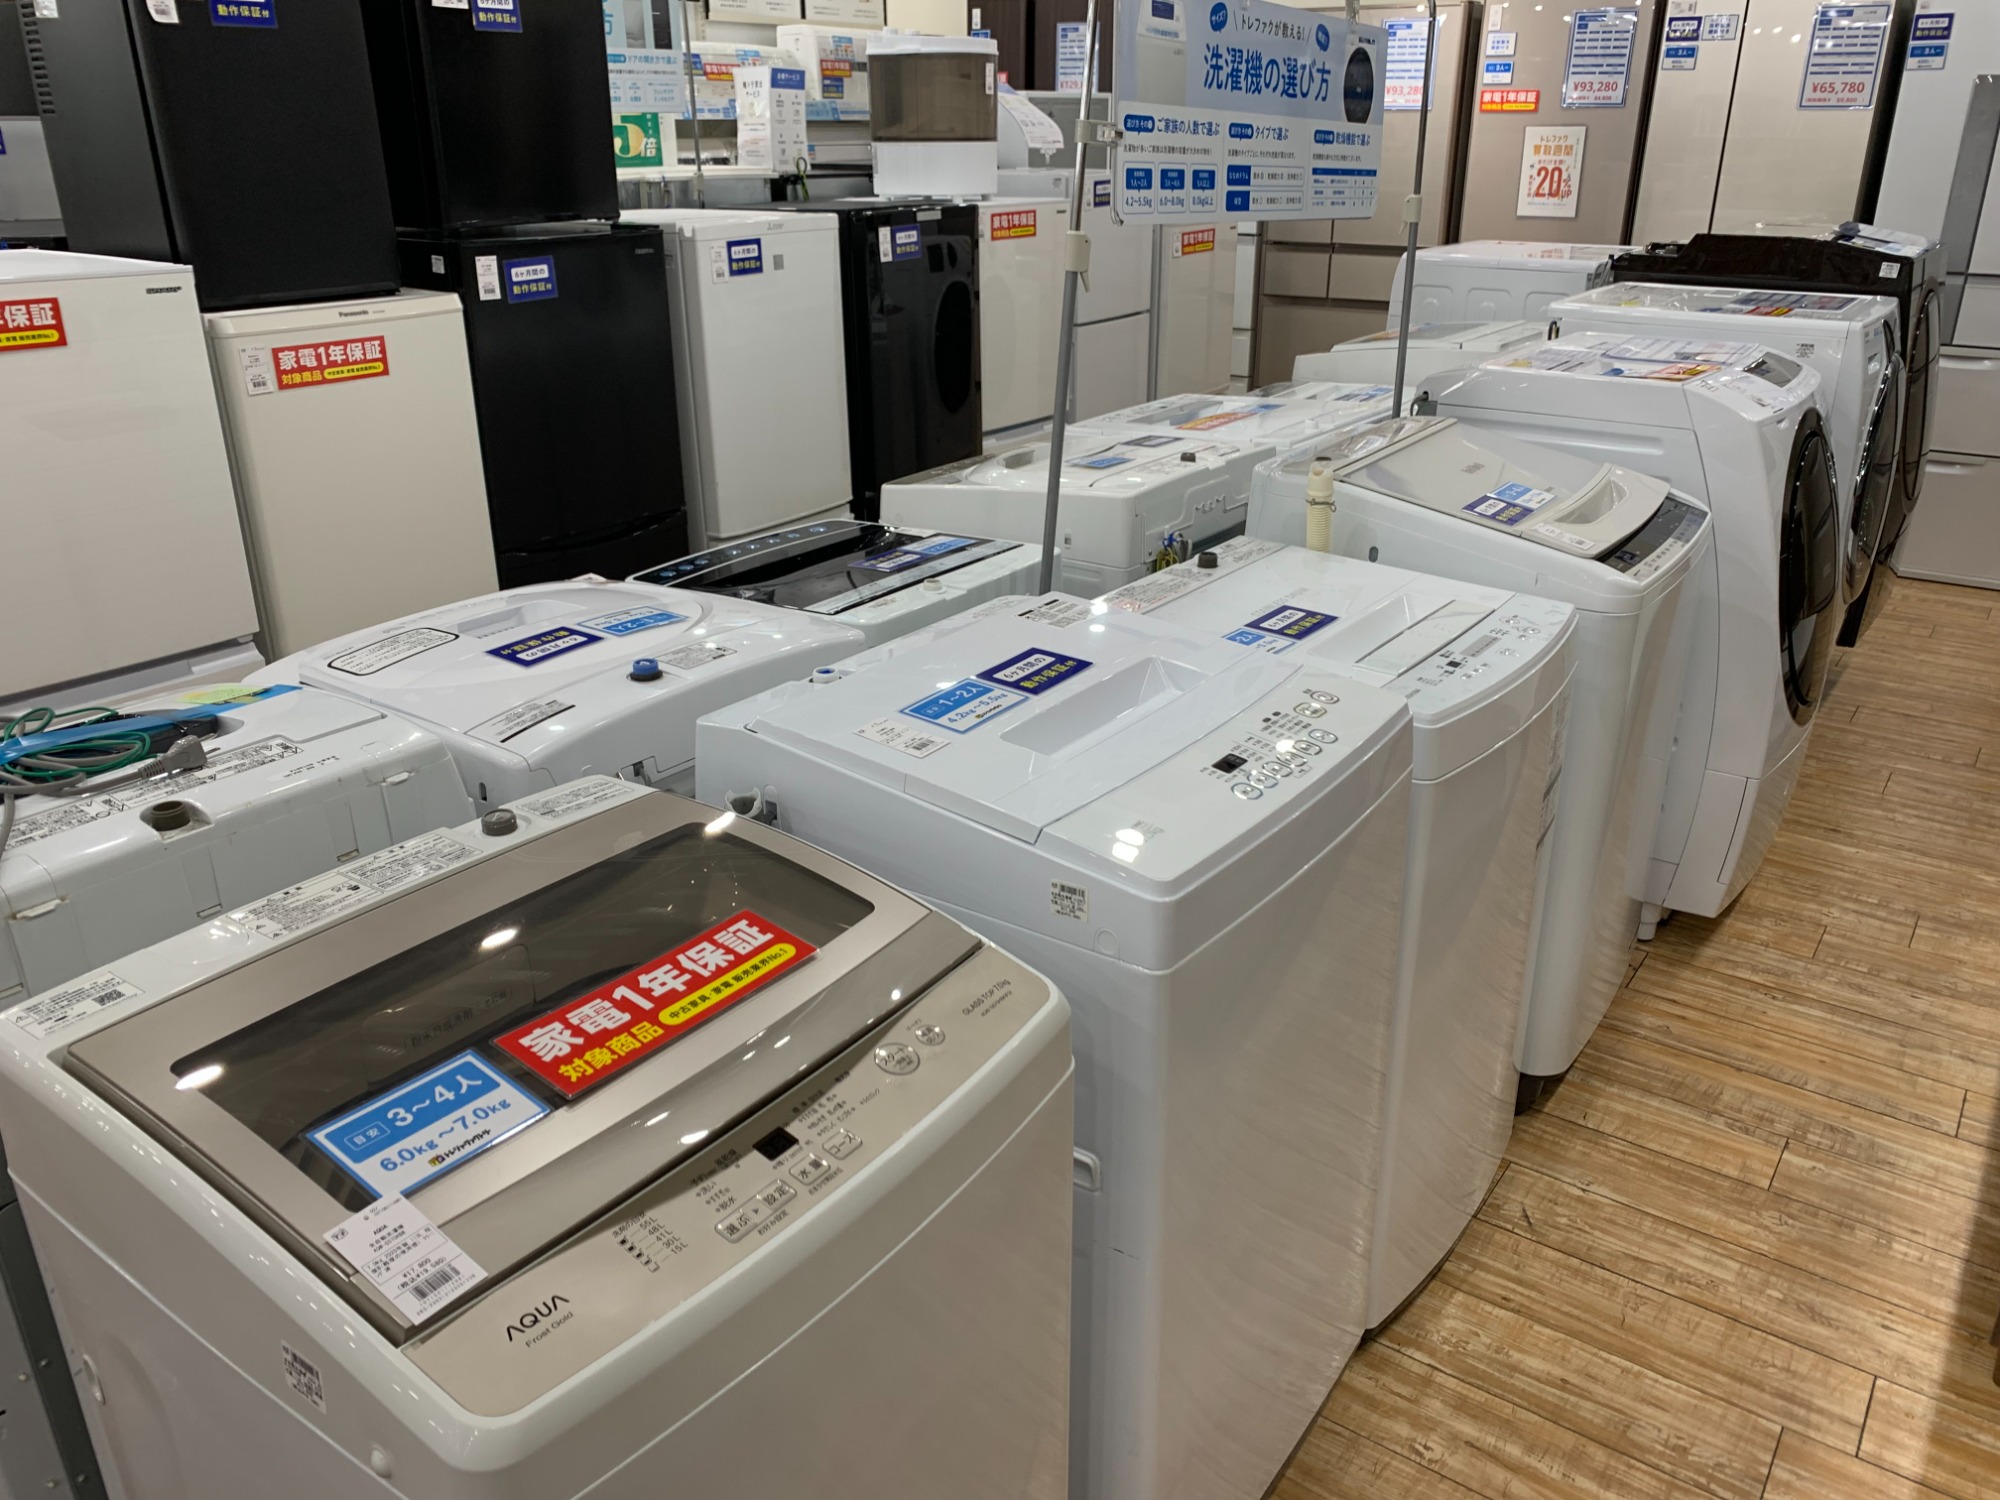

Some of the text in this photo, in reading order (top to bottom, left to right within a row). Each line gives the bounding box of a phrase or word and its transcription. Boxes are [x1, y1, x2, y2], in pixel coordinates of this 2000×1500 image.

[479, 11, 517, 24] 動作保証付
[1204, 43, 1332, 102] 洗濯機の選び方
[1573, 81, 1618, 93] ¥93,280
[1812, 82, 1865, 95] ¥65,780
[1482, 91, 1537, 103] 家電1年保証
[1157, 117, 1220, 137] ご家族の人数で選ぶ
[1255, 126, 1290, 141] タイプで選ぶ
[1540, 135, 1568, 143] トレファク
[1533, 144, 1574, 156] 買取週間
[1126, 197, 1152, 208] 4.2～5.5kg
[992, 212, 1035, 229] 家電1年保証
[514, 268, 545, 279] 6ヶ月間の
[732, 260, 760, 270] 動作保証付
[513, 282, 552, 295] 動作保証付
[338, 309, 369, 318] Panasonic
[278, 339, 383, 371] 家電1年保証
[281, 370, 322, 386] 対象商品
[610, 616, 654, 631] 1～2人
[1267, 611, 1299, 628] 6ヶ月間の
[1283, 614, 1326, 635] 動作保証付
[501, 630, 570, 655] 動作保証付
[525, 636, 578, 659] 6ヶ月間の
[1003, 656, 1046, 681] 6ヶ月間の
[1020, 659, 1077, 689] 動作保証付
[939, 684, 984, 706] 1～2人
[947, 691, 1008, 724] 4.2kg～5.5kg
[518, 919, 775, 1062] 家電1年保証
[558, 1021, 665, 1083] 対象商品
[732, 947, 788, 984] 販売業界No.1
[353, 1074, 482, 1145] 目安 3～4人
[380, 1099, 512, 1172] 6.0kg～7.0kg
[829, 1134, 856, 1156] コース
[797, 1158, 824, 1180] 水量
[762, 1185, 790, 1207] 設定
[639, 1216, 658, 1230] 55L
[648, 1223, 666, 1236] 48L
[655, 1229, 673, 1242] 41L
[662, 1235, 681, 1249] 30L
[670, 1242, 689, 1255] 15L
[401, 1257, 432, 1279] ¥17,800
[506, 1294, 570, 1343] AQUA
[525, 1311, 574, 1348] Frost Gold
